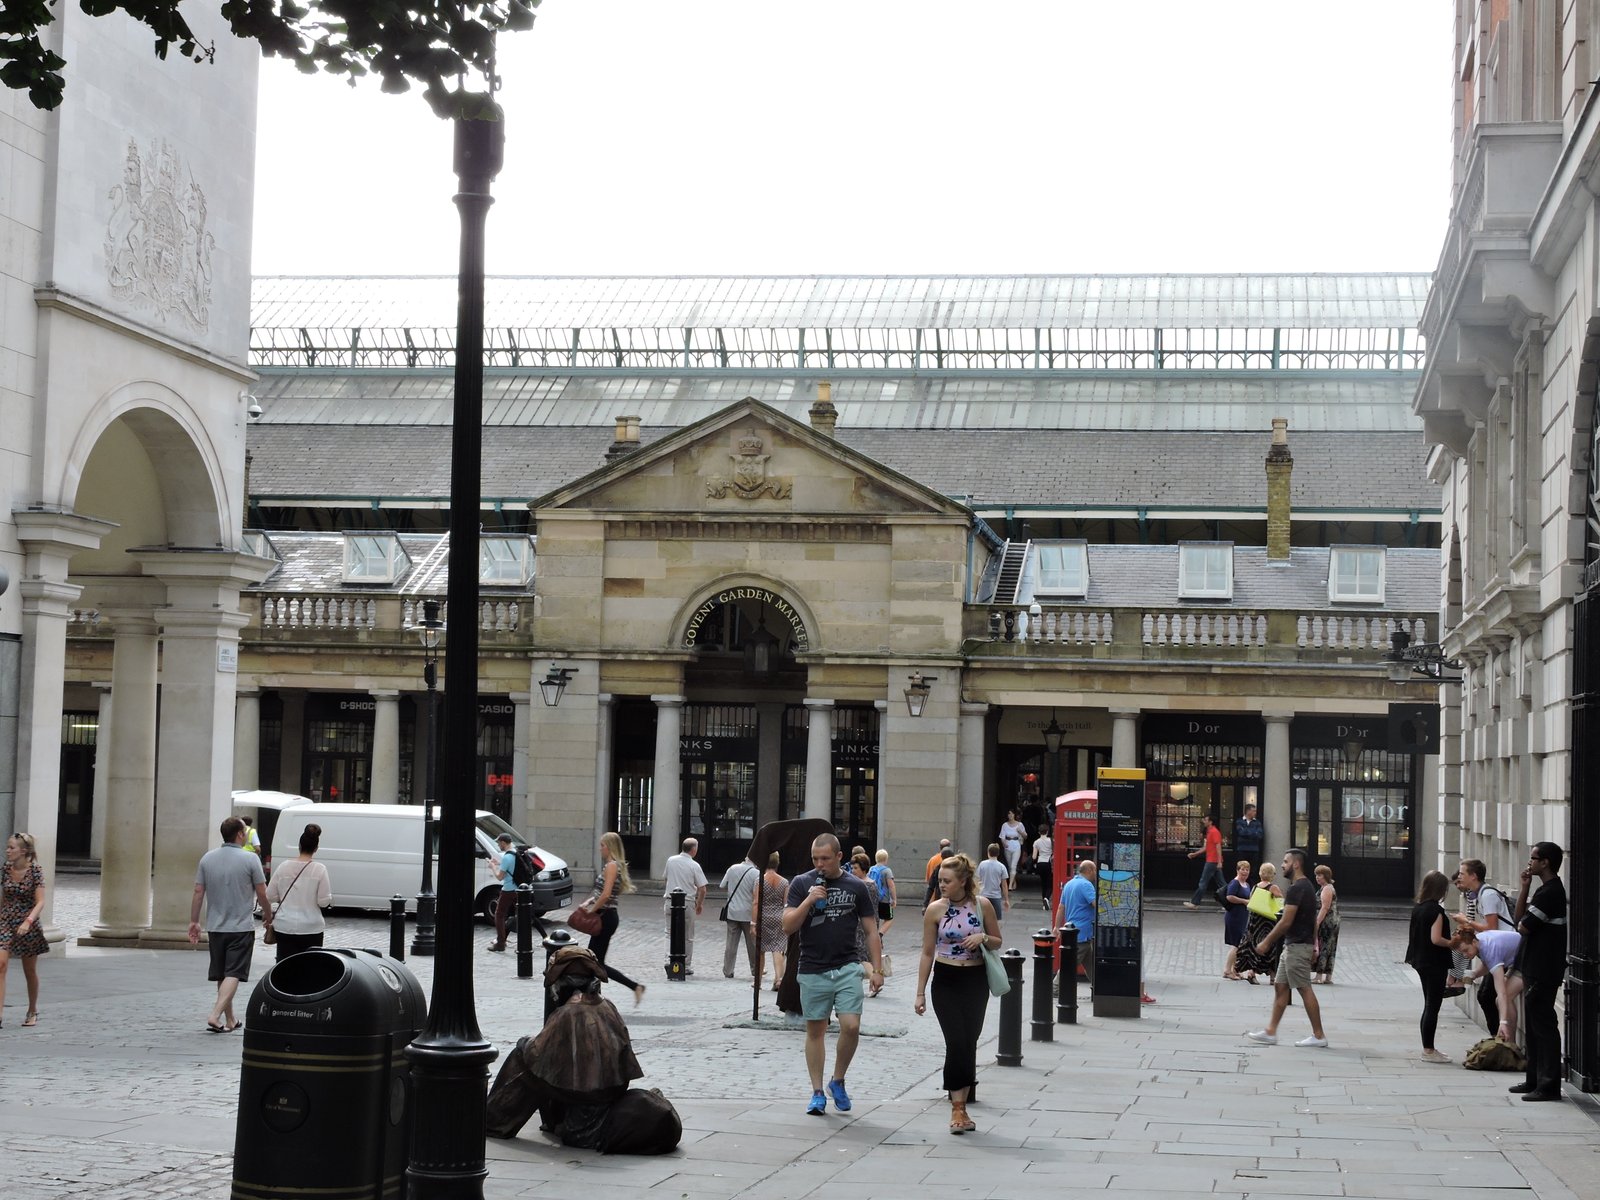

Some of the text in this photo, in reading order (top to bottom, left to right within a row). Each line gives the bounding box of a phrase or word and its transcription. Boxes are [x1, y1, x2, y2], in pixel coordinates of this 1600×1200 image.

[686, 588, 809, 651] COVENT GARDEN MARKET
[340, 701, 376, 710] G-SHOC
[1188, 721, 1220, 733] Dor
[1344, 797, 1409, 820] Dior
